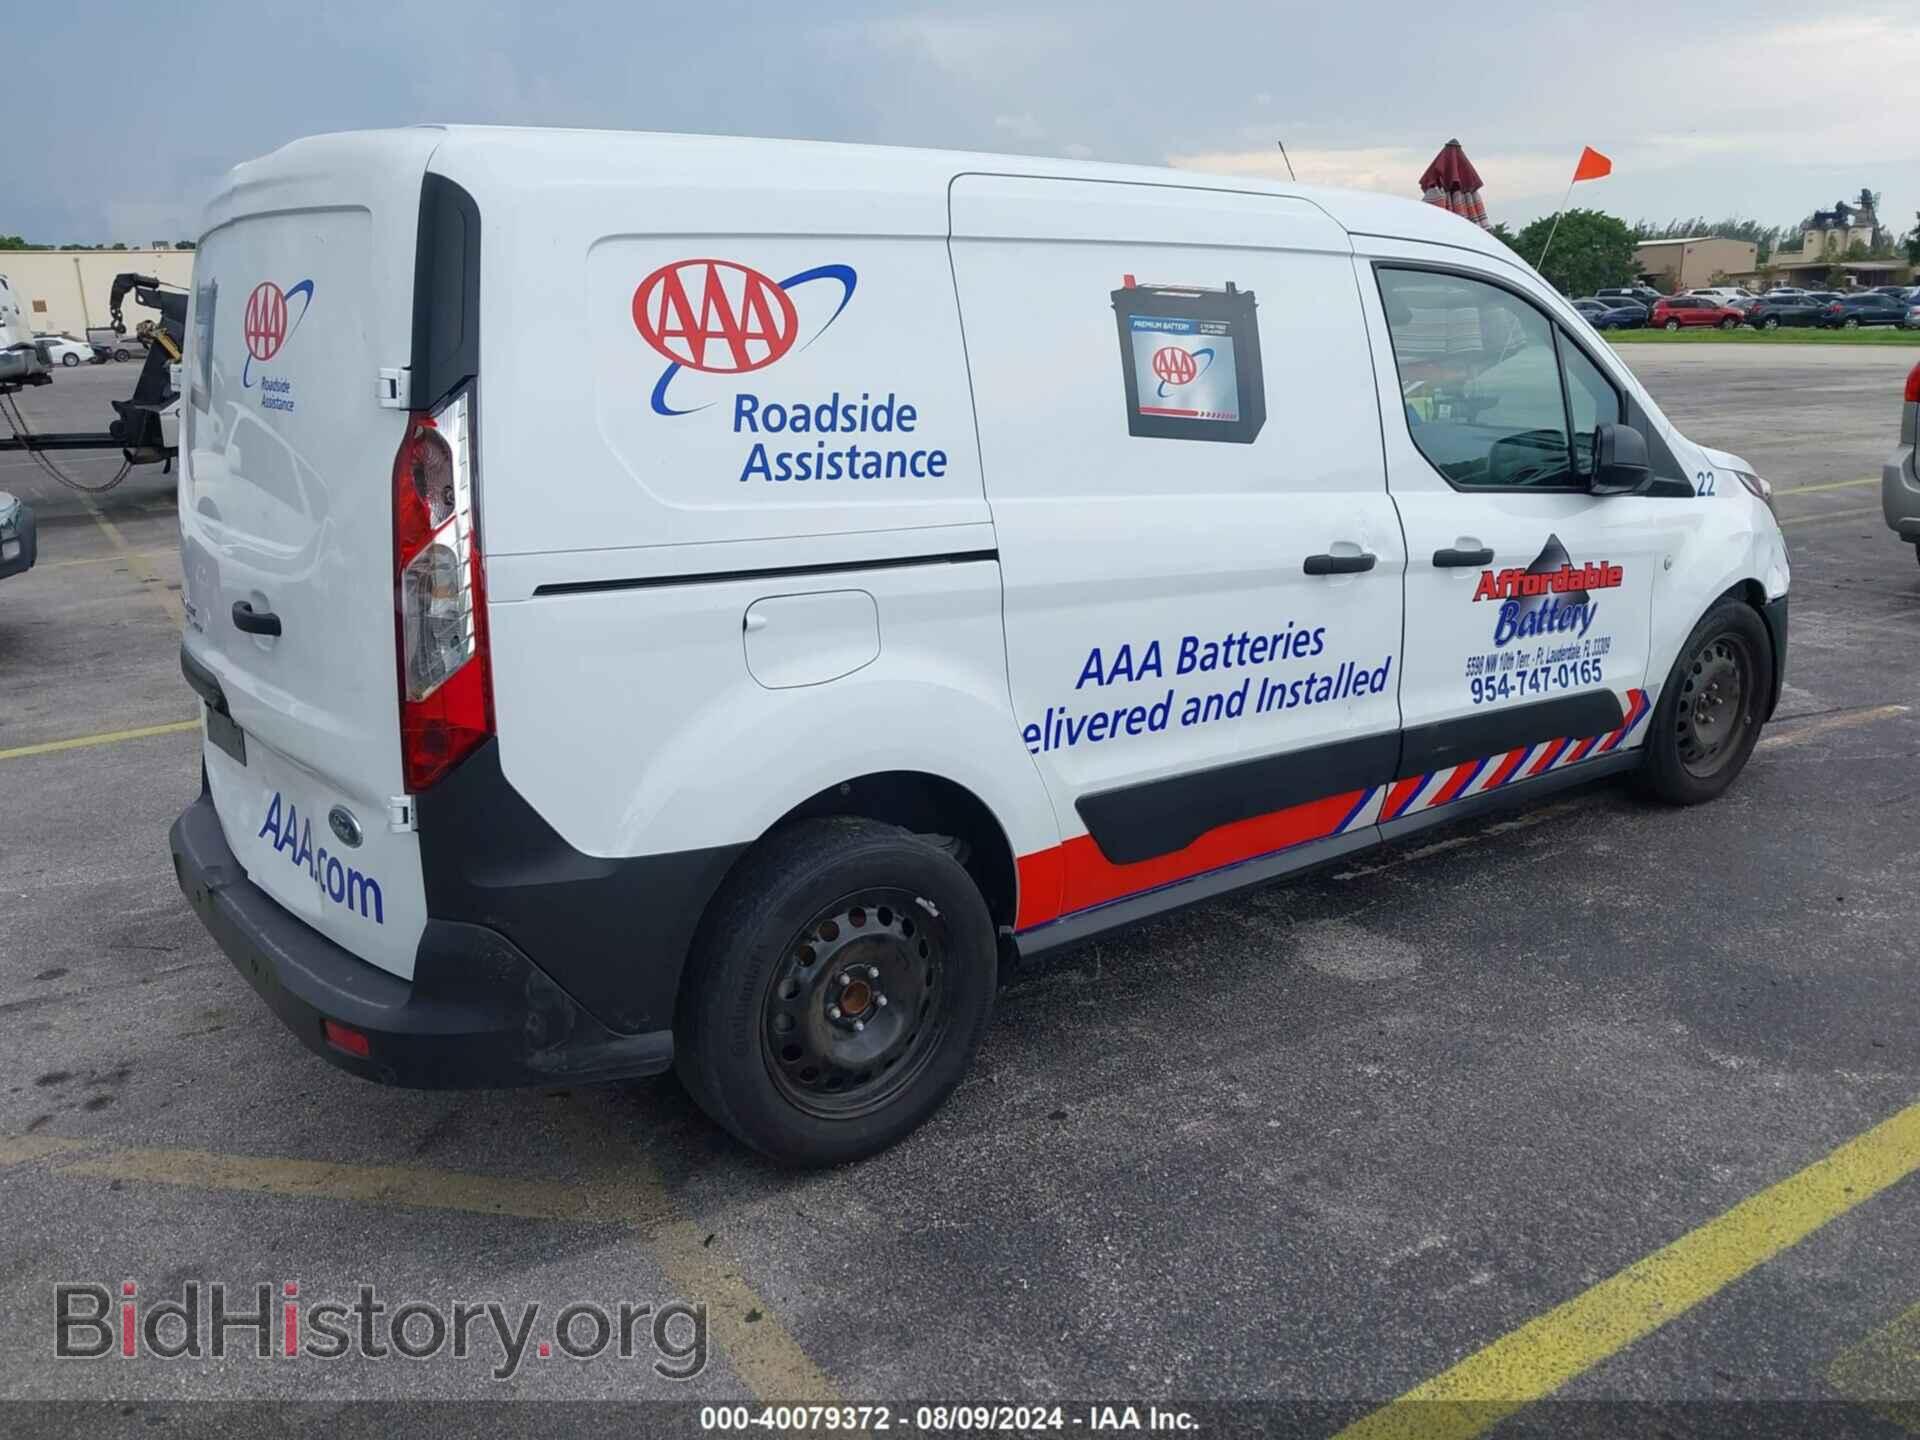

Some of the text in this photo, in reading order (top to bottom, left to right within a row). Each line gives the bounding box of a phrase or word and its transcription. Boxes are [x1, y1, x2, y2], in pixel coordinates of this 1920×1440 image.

[246, 282, 286, 360] AAA
[650, 259, 790, 373] AAA
[1154, 347, 1196, 384] AAA
[733, 392, 917, 433] Roadside
[739, 440, 948, 482] Assistance
[1697, 472, 1715, 497] 22
[1472, 561, 1624, 602] Affordable
[1494, 599, 1599, 648] Battery
[1075, 621, 1326, 690] AAA Batteries
[1485, 653, 1499, 674] NW
[1180, 678, 1250, 726] and
[1255, 656, 1393, 714] Installed
[1471, 658, 1603, 705] 954-747-0165
[258, 791, 384, 925] AAA.com
